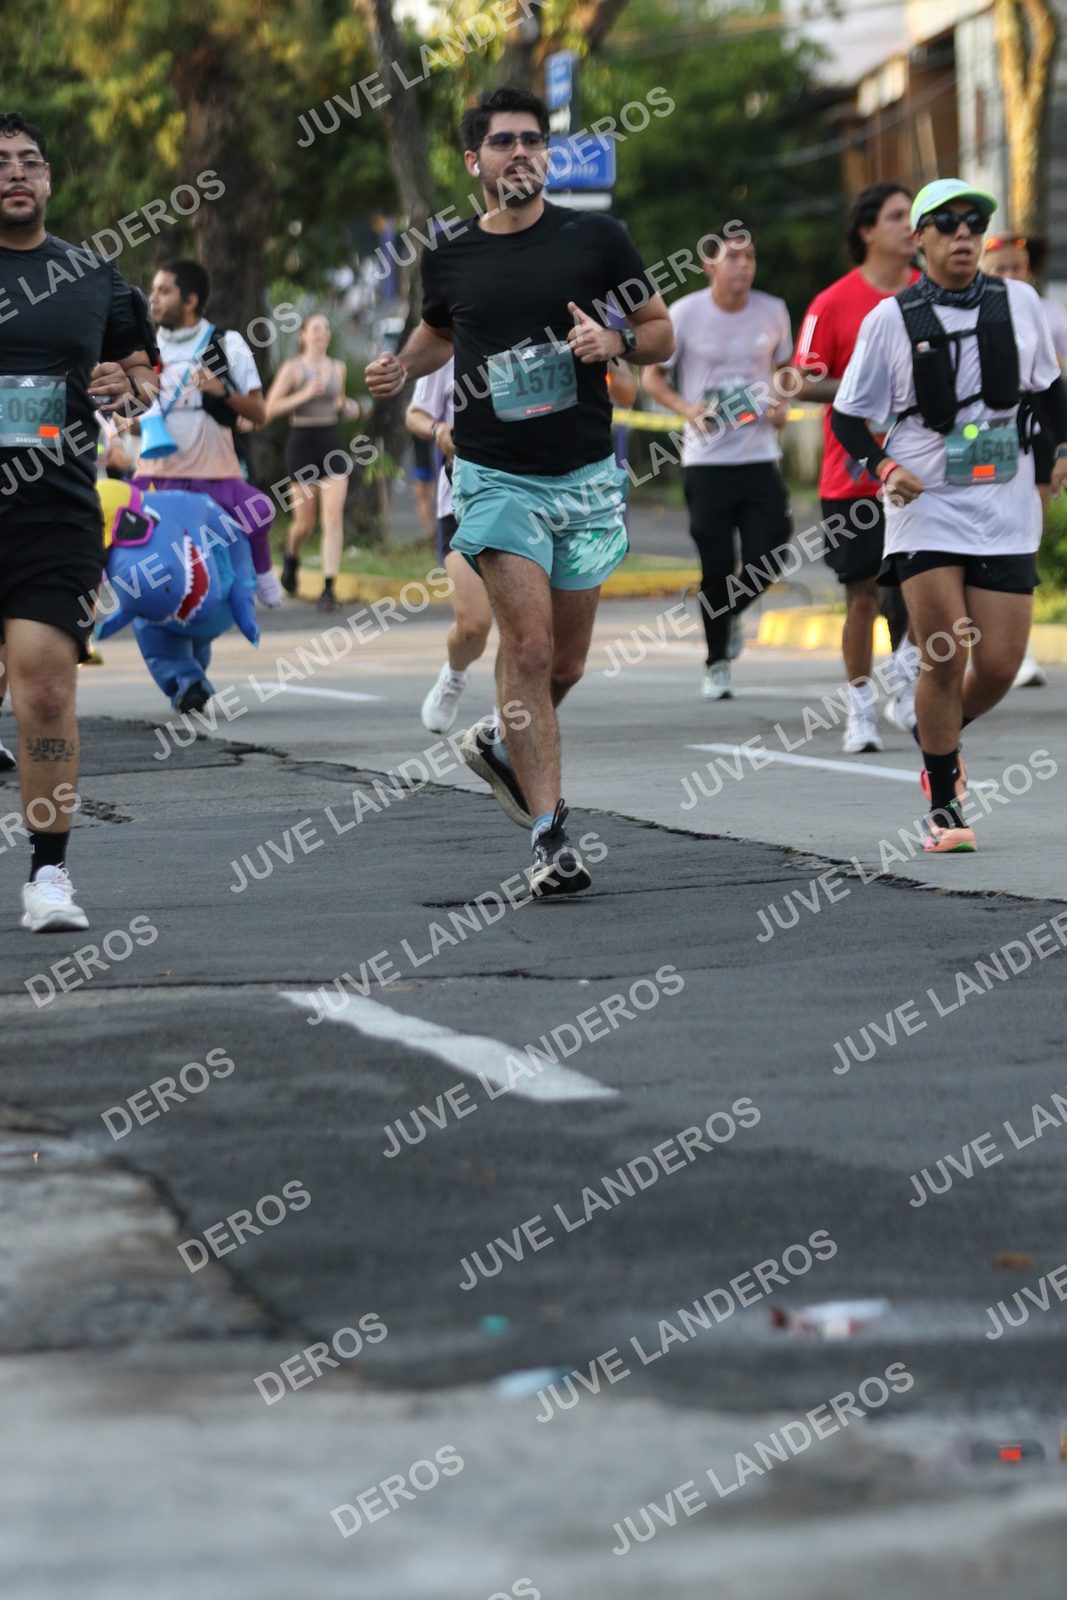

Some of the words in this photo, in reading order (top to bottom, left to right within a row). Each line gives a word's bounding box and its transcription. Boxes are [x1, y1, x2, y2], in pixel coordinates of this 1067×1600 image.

[514, 361, 575, 397] 1573
[8, 397, 65, 423] 0628
[968, 437, 1017, 464] 1541
